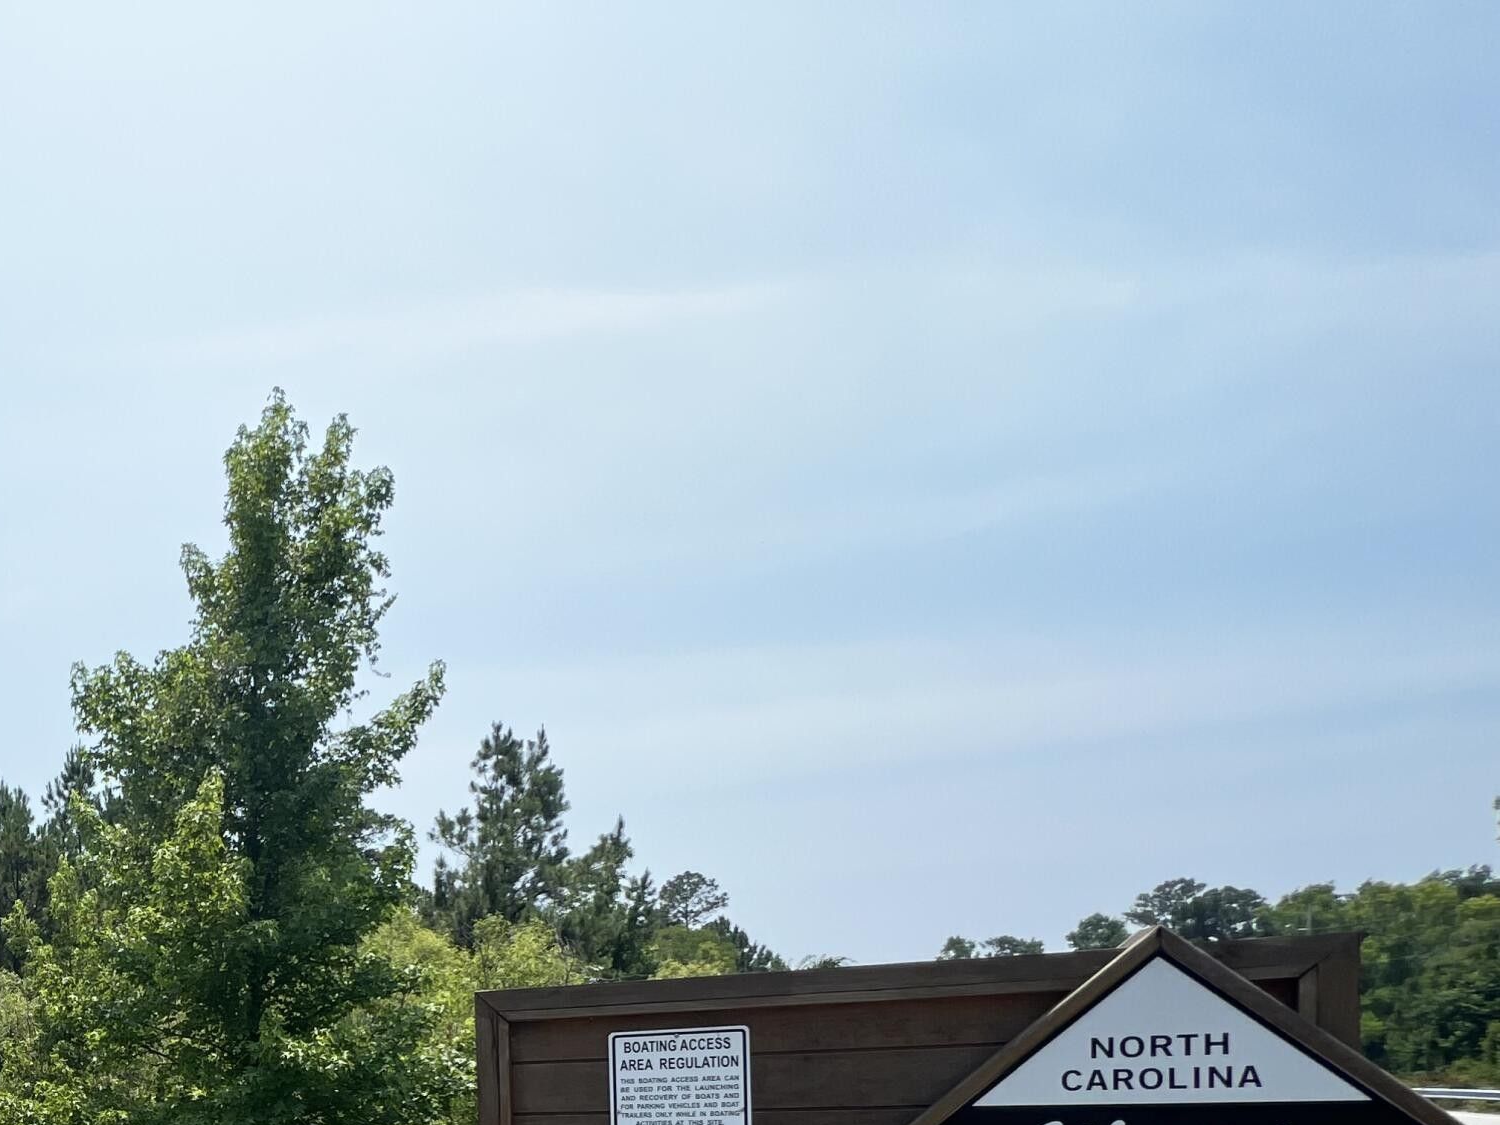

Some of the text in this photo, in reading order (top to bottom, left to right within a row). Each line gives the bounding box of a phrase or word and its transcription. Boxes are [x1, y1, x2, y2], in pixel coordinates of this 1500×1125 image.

[624, 1037, 731, 1054] BOATING ACCESS
[1090, 1032, 1230, 1058] NORTH
[620, 1055, 739, 1071] AREA REGULATION
[1061, 1066, 1262, 1091] CAROLINA
